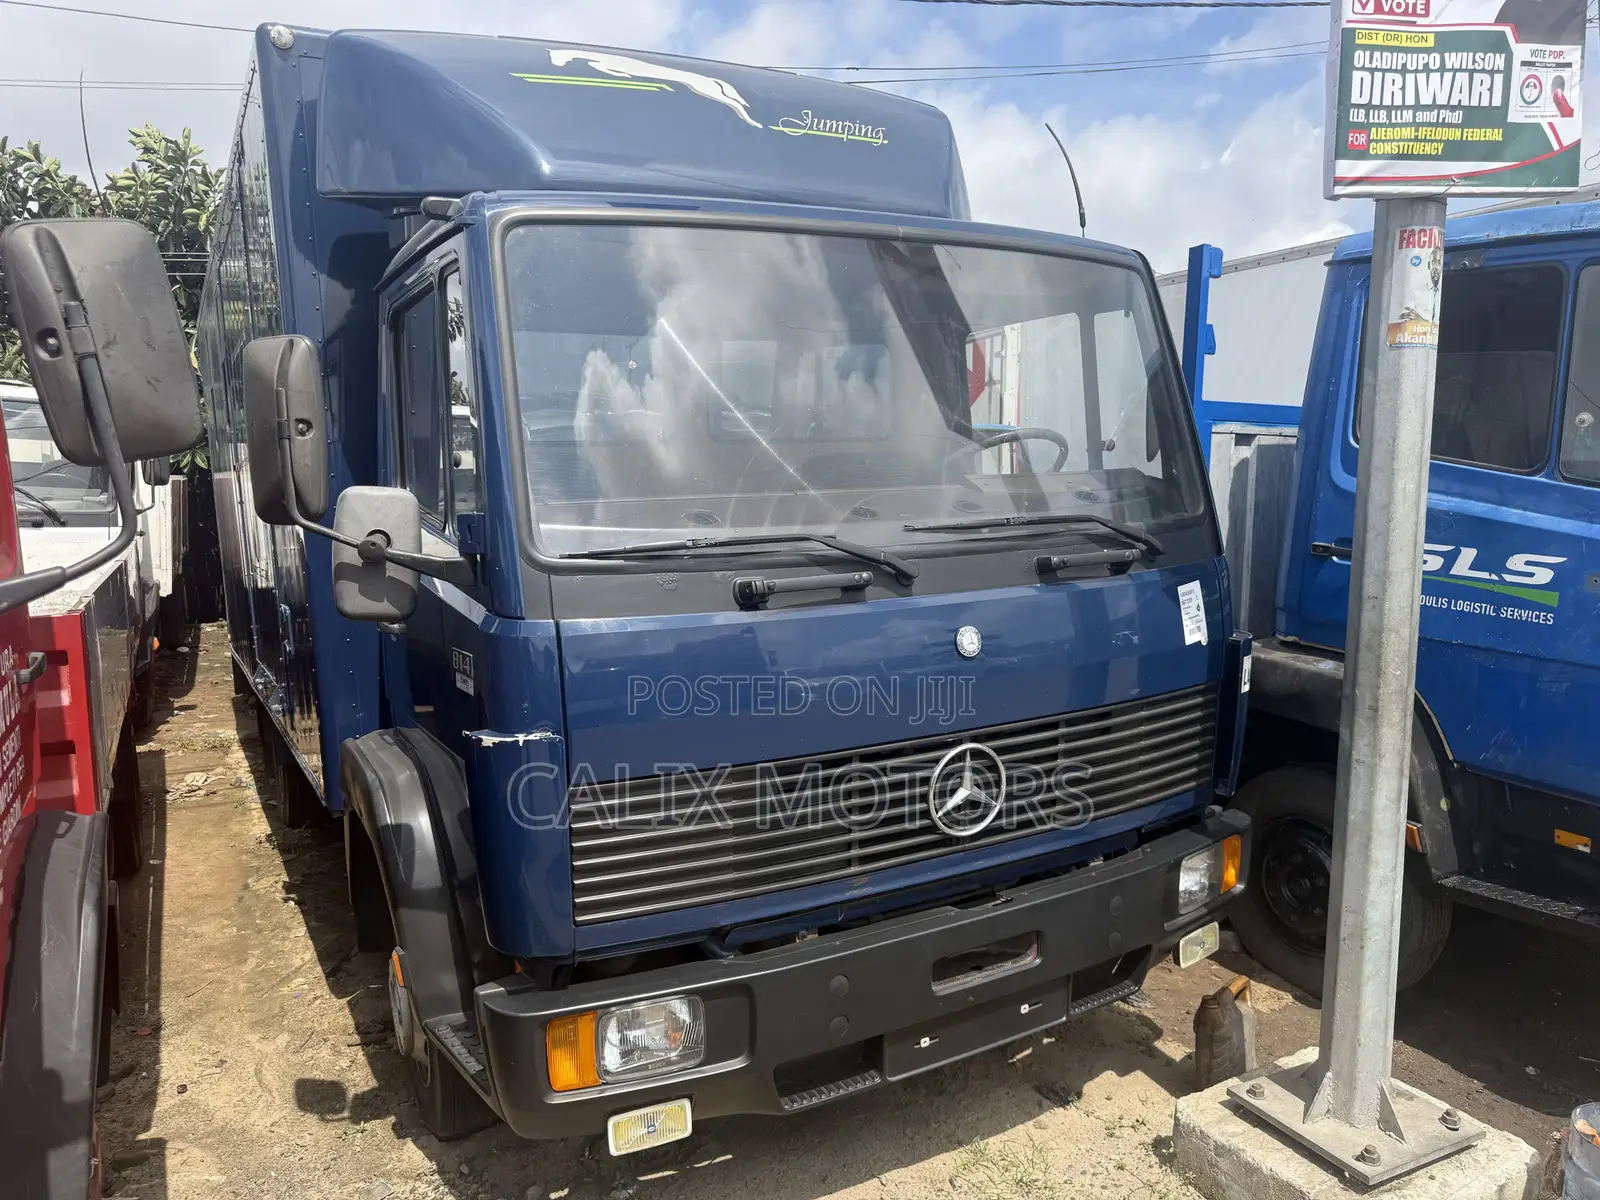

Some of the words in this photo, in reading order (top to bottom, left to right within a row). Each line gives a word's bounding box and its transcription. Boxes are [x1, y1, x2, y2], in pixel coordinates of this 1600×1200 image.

[1381, 0, 1426, 14] VOTE
[1357, 31, 1380, 41] DIST
[1382, 33, 1403, 44] (DR)
[1405, 35, 1428, 43] HON
[1353, 50, 1440, 70] OLADIPUPO
[1444, 52, 1505, 71] WILSON
[1530, 49, 1547, 59] VOTE
[1548, 50, 1565, 59] PDP.
[1350, 71, 1504, 107] DIRIWARI
[1349, 109, 1367, 124] (LB,
[1369, 109, 1389, 124] LLB,
[1391, 110, 1413, 123] LLM
[1415, 110, 1437, 123] and
[1438, 111, 1463, 124] Phd)
[779, 110, 885, 146] Jumping
[1370, 127, 1461, 140] AJEROMI-IFELODUN
[1463, 128, 1503, 141] FEDERAL
[1348, 133, 1366, 145] FOR
[1369, 142, 1444, 155] CONSTITUENCY
[1451, 599, 1496, 616] LOGISTIC
[1499, 606, 1554, 625] SERVICES
[452, 650, 470, 676] 814
